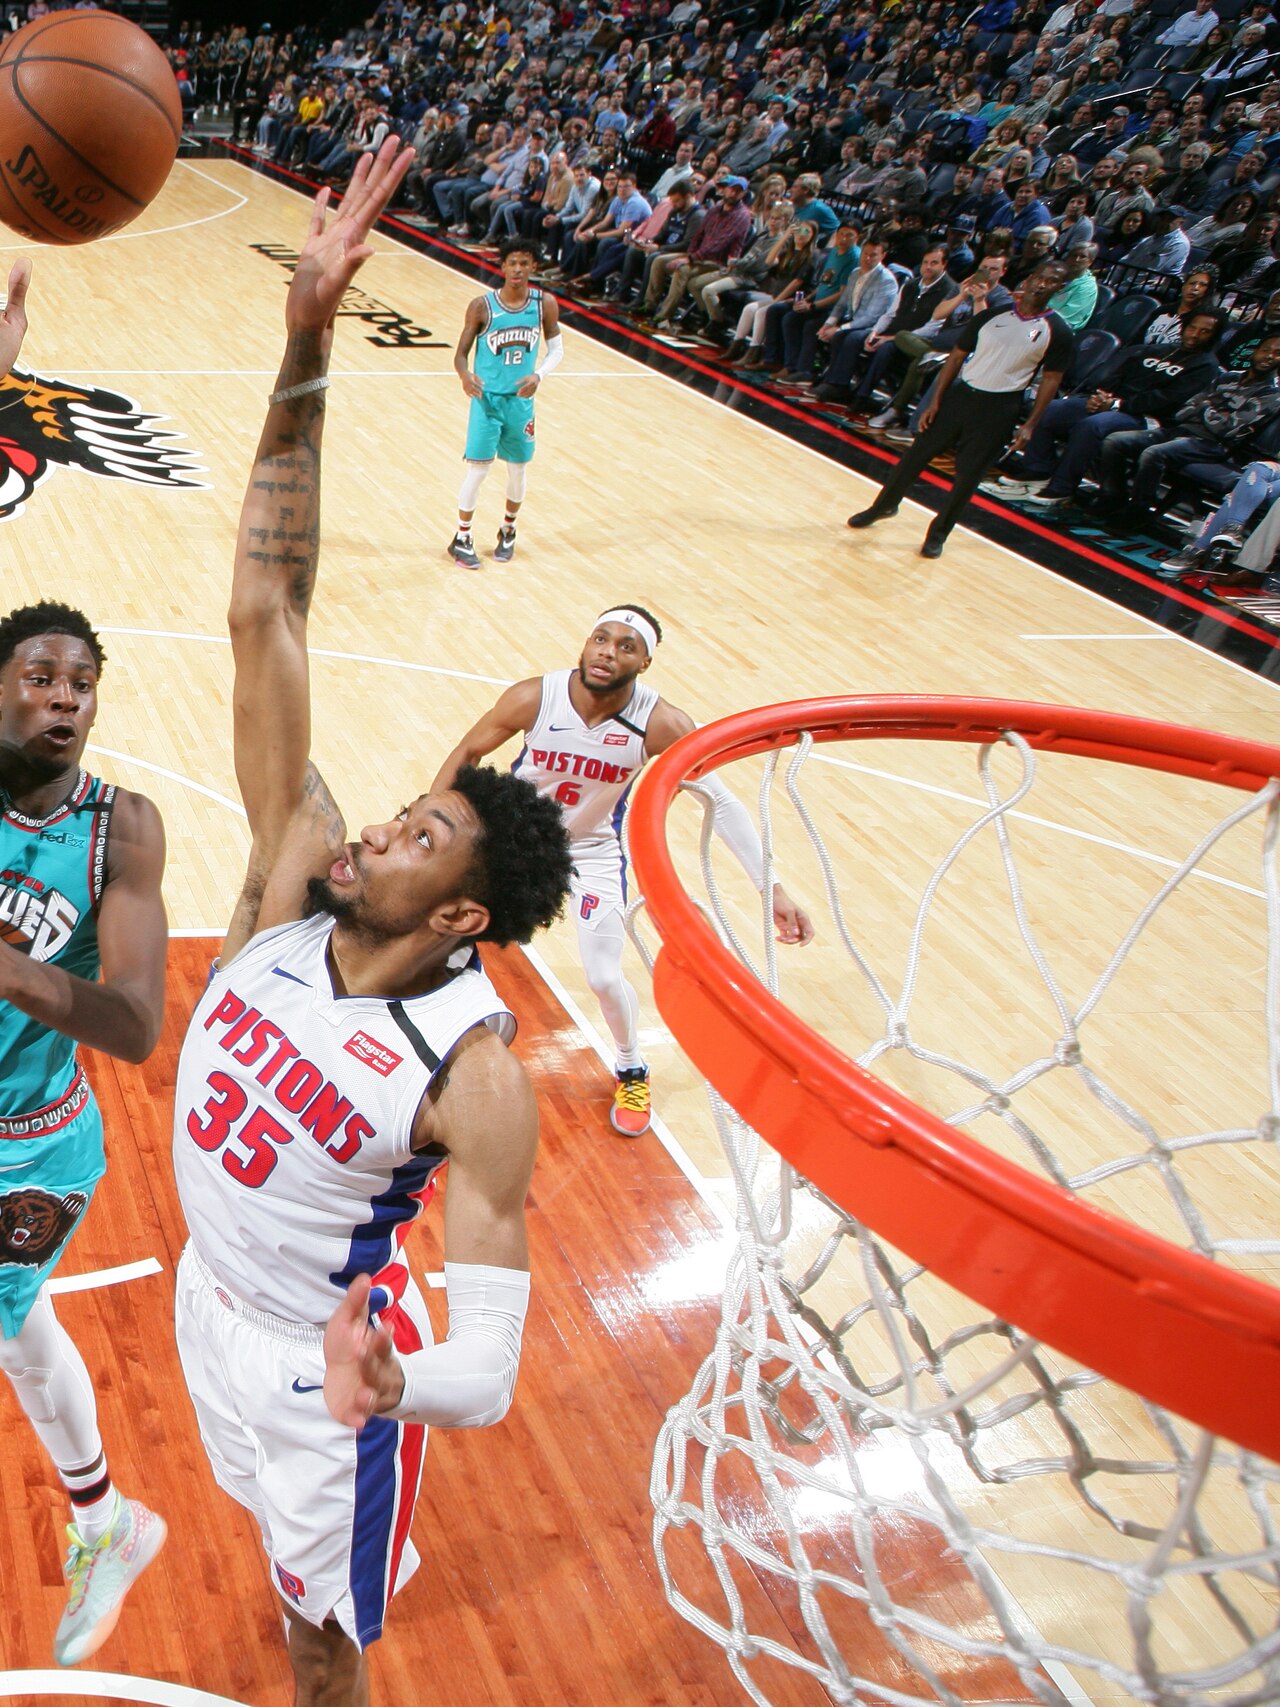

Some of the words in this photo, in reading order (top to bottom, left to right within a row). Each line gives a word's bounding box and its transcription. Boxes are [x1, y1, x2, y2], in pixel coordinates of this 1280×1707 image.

[486, 327, 539, 356] GRIZZLIES
[503, 349, 522, 365] 12
[531, 749, 633, 784] PISTONS
[555, 781, 583, 806] 6
[39, 830, 85, 849] FedEx
[352, 1033, 397, 1065] Flagstar
[203, 987, 377, 1164] PISTONS
[371, 1058, 388, 1072] Bank
[186, 1070, 294, 1189] 35
